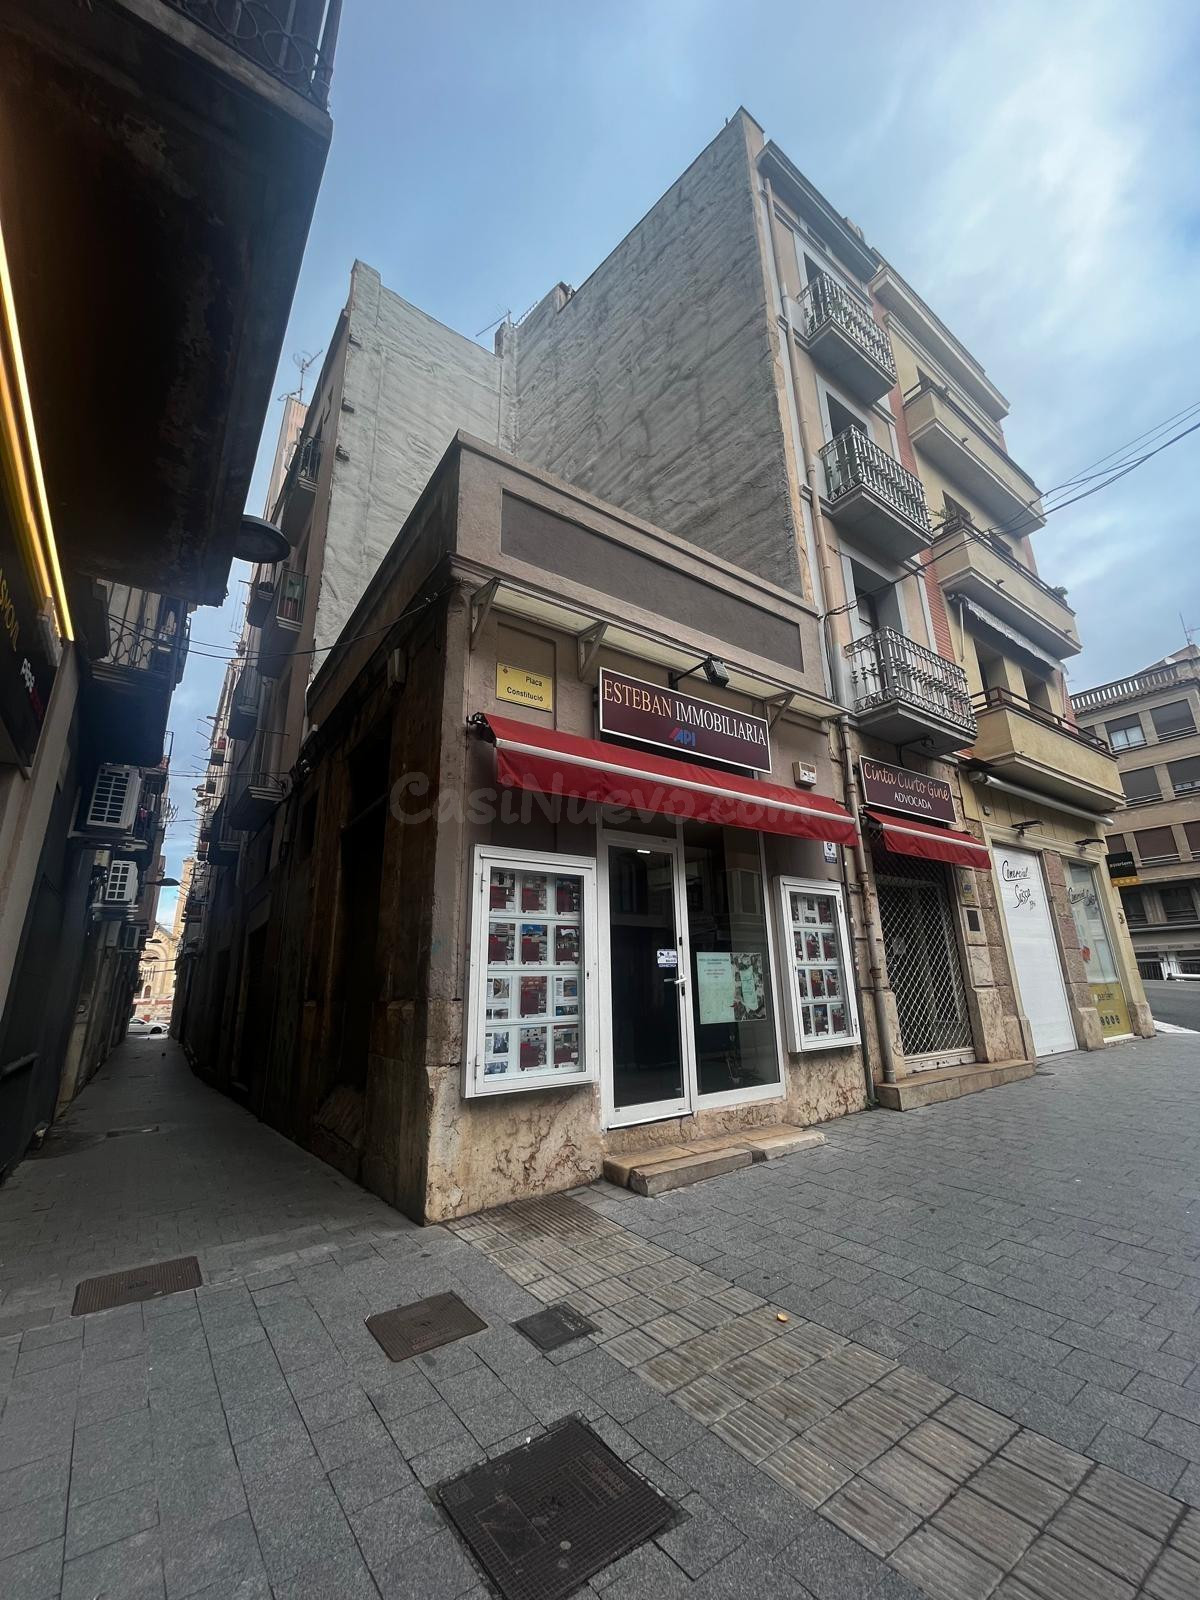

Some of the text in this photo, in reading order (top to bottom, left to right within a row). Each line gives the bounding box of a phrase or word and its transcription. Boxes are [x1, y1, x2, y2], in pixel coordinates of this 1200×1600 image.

[506, 686, 544, 702] Constitució
[603, 679, 767, 746] ESTEBAN IMMOBILIARIA
[669, 727, 696, 747] API
[864, 762, 950, 801] Cinta Curto Giné
[894, 791, 932, 810] ADVOCADA
